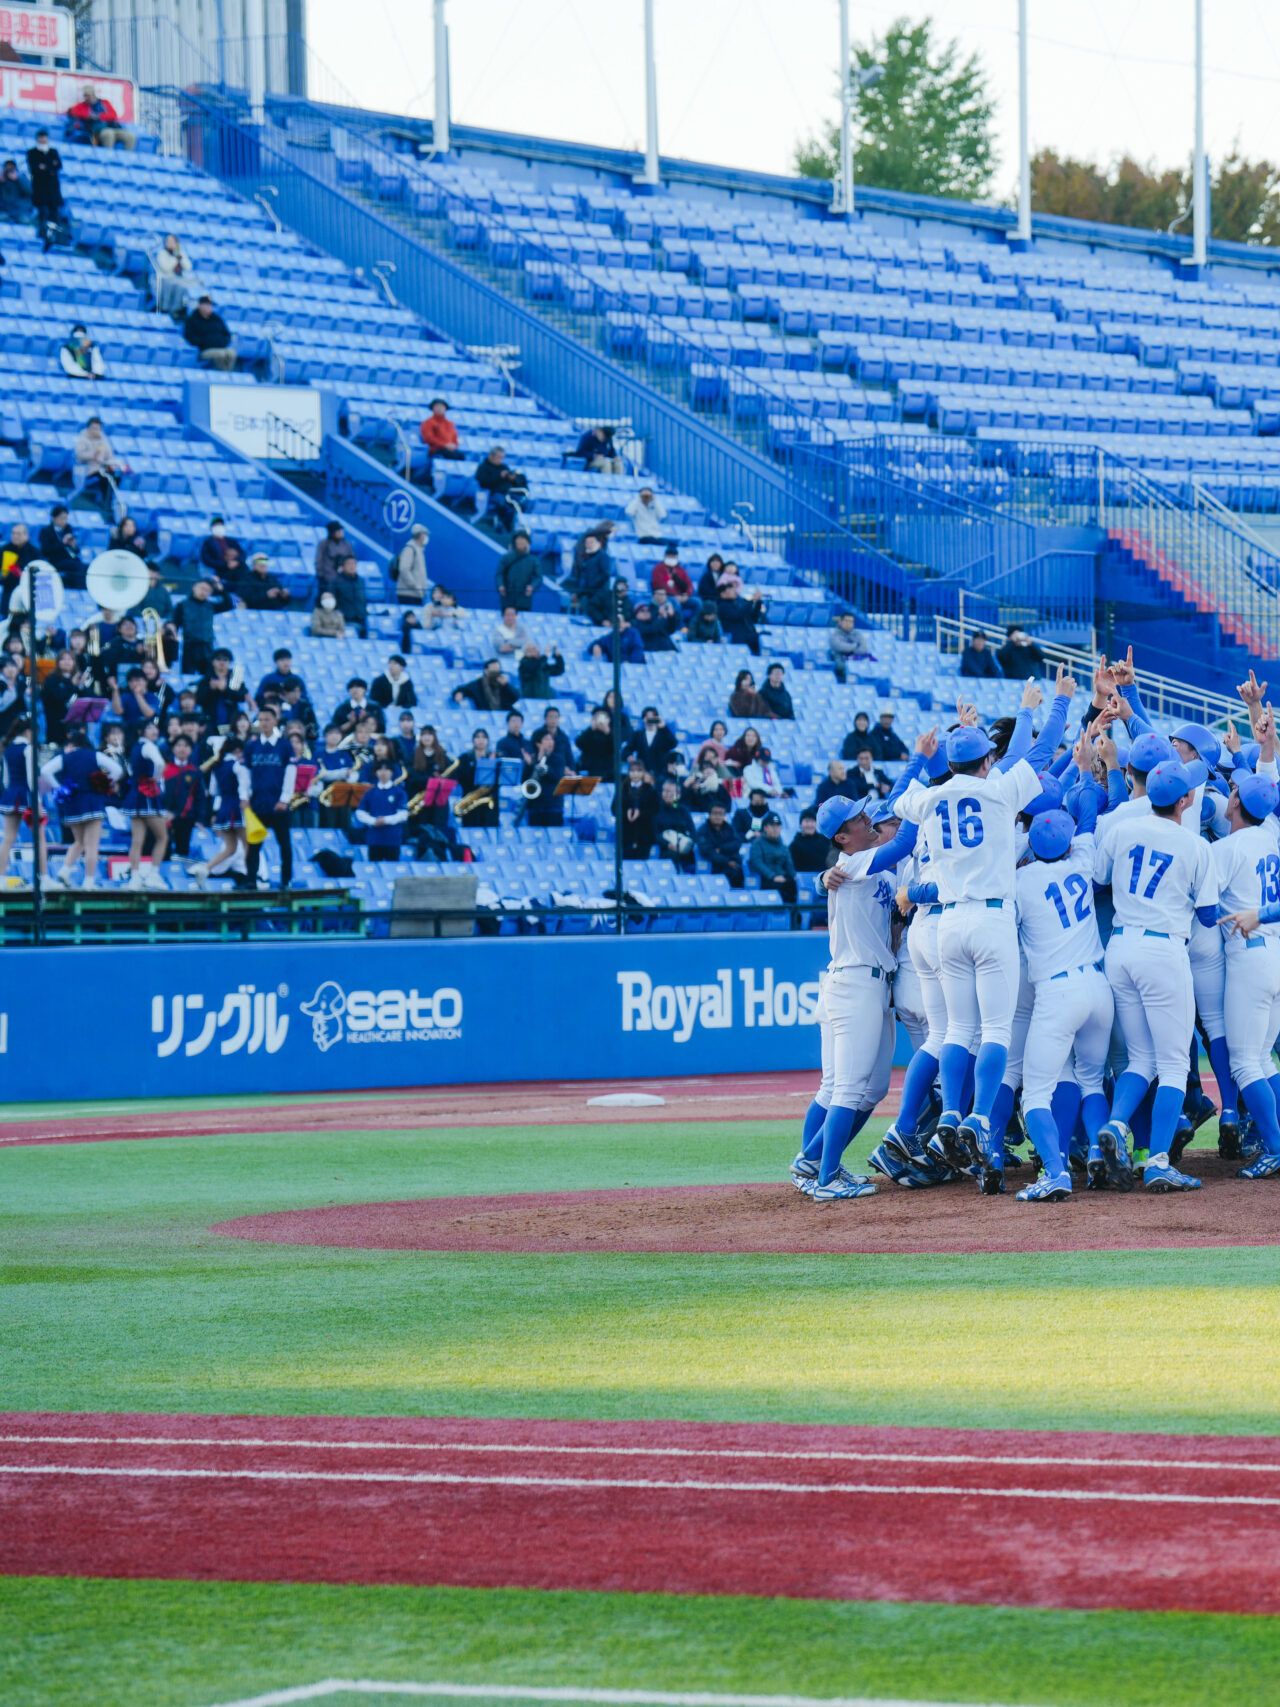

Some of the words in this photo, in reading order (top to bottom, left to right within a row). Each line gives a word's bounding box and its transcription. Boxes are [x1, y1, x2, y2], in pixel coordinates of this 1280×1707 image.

[391, 499, 409, 522] 12
[935, 797, 984, 849] 16
[1128, 844, 1174, 900] 17
[1255, 854, 1280, 907] 13
[1044, 873, 1092, 929] 12
[346, 988, 462, 1031] sato
[617, 968, 733, 1043] Royal
[739, 967, 828, 1027] Hos
[347, 1030, 403, 1043] HEALTHCARE
[405, 1028, 462, 1041] INNOVATION
